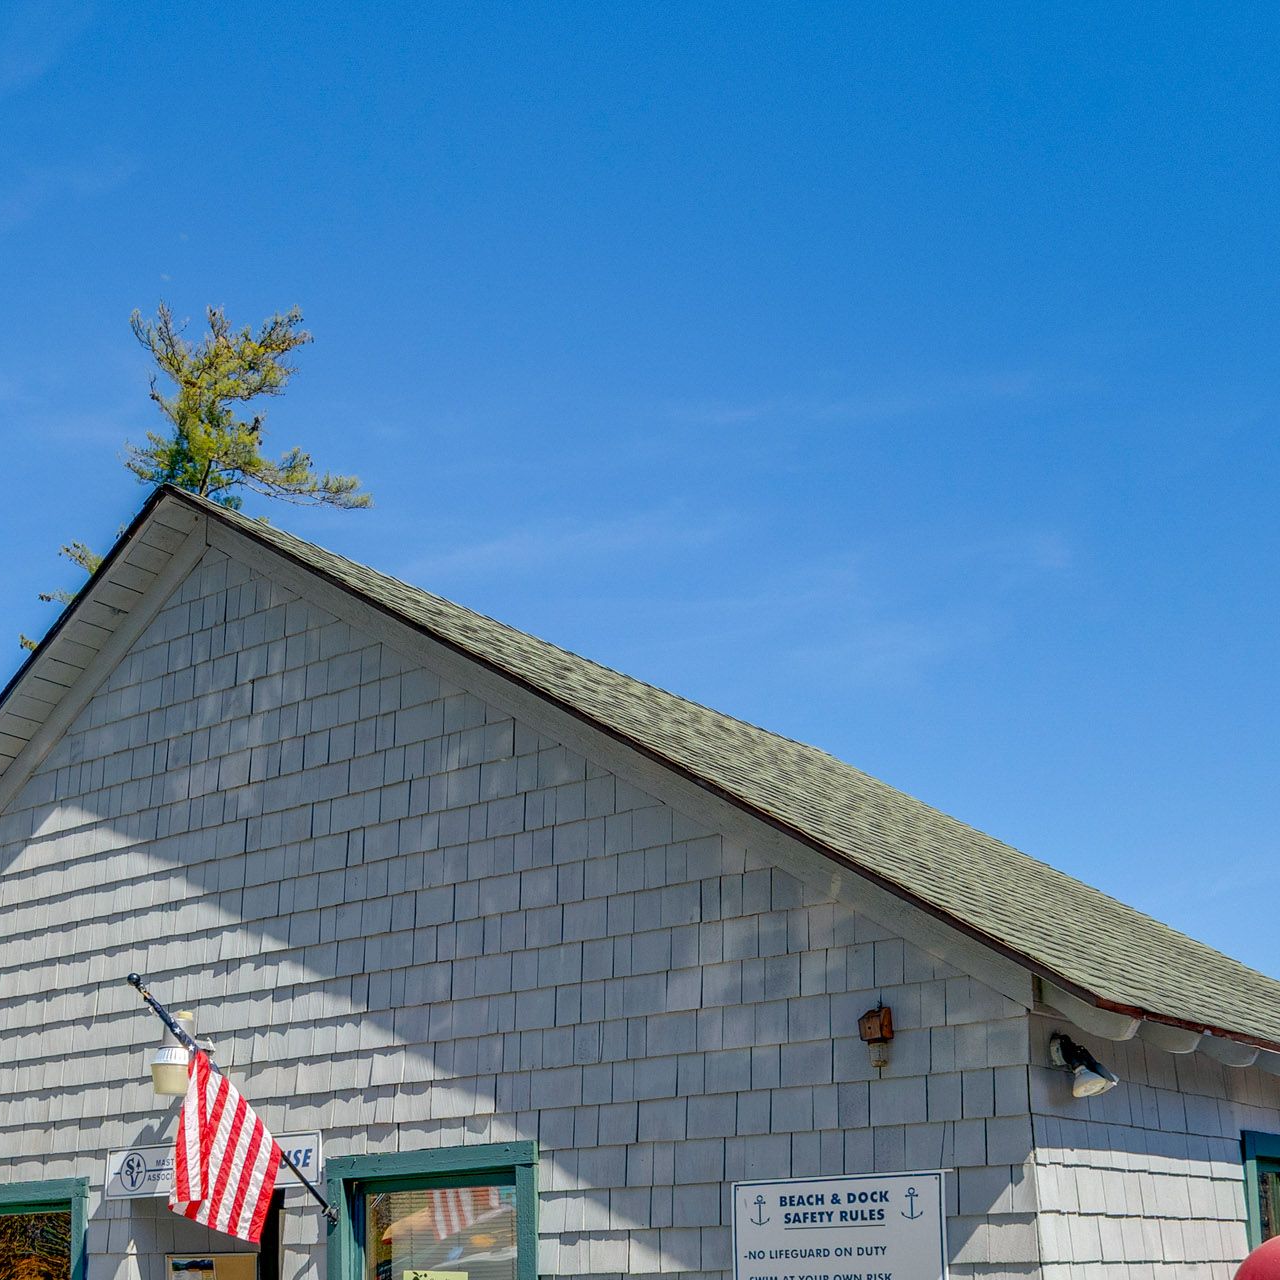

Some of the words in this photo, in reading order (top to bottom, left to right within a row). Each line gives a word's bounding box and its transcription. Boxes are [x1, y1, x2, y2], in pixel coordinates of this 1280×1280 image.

[779, 1194, 825, 1207] BEACH
[831, 1193, 841, 1205] &
[847, 1190, 890, 1203] DOCK
[784, 1209, 834, 1224] SAFETY
[839, 1208, 885, 1221] RULES
[743, 1250, 766, 1260] -NO
[769, 1248, 830, 1259] LIFEGUARD
[835, 1247, 853, 1257] ON
[857, 1246, 887, 1256] DUTY
